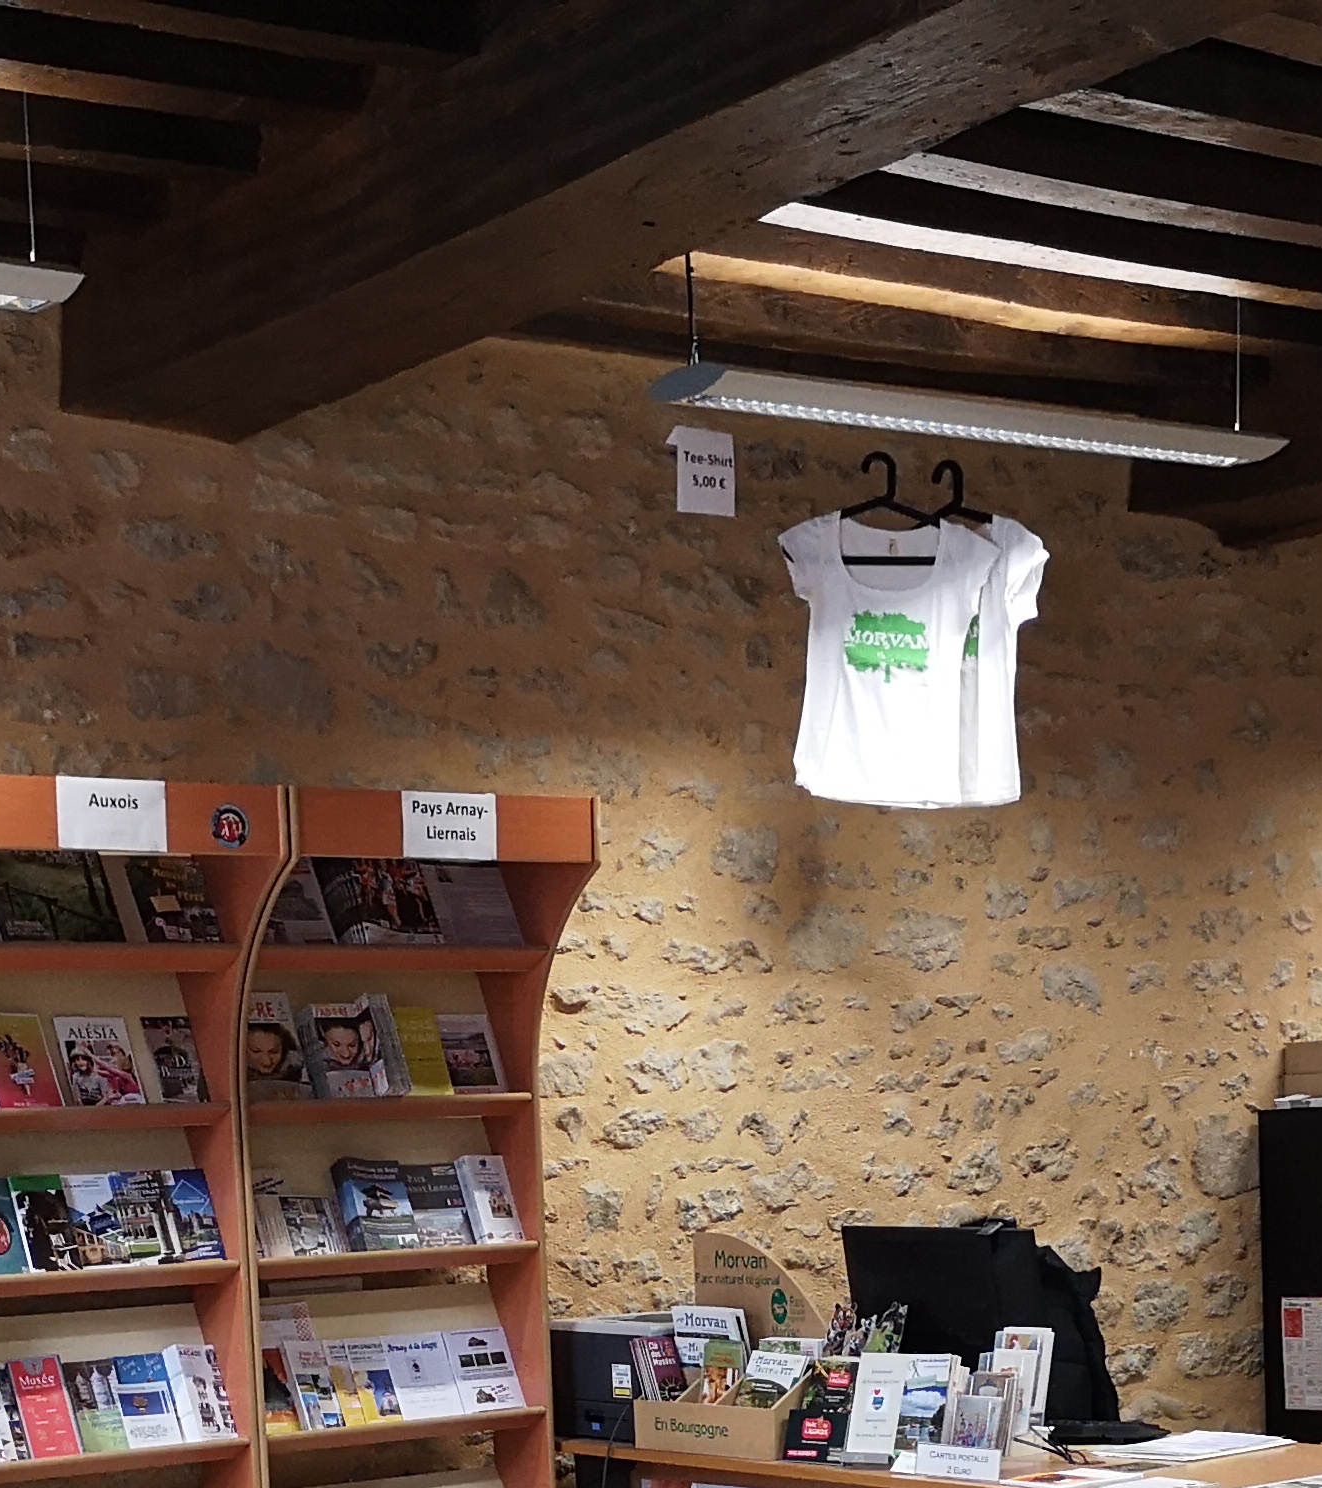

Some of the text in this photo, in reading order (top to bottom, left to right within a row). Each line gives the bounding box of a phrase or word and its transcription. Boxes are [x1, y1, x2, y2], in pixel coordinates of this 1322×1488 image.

[683, 450, 733, 468] Tee-Shirt
[692, 475, 727, 490] 5,00 €
[845, 629, 929, 651] MORVAN
[88, 792, 139, 810] Auxois
[411, 799, 489, 820] Pays Arnay-
[426, 825, 477, 842] Liernais
[714, 1250, 768, 1269] Morvan
[684, 1312, 728, 1329] Morvan
[18, 1374, 56, 1386] Musée
[654, 1417, 729, 1439] En Bourgogne
[929, 1450, 957, 1461] CARTES
